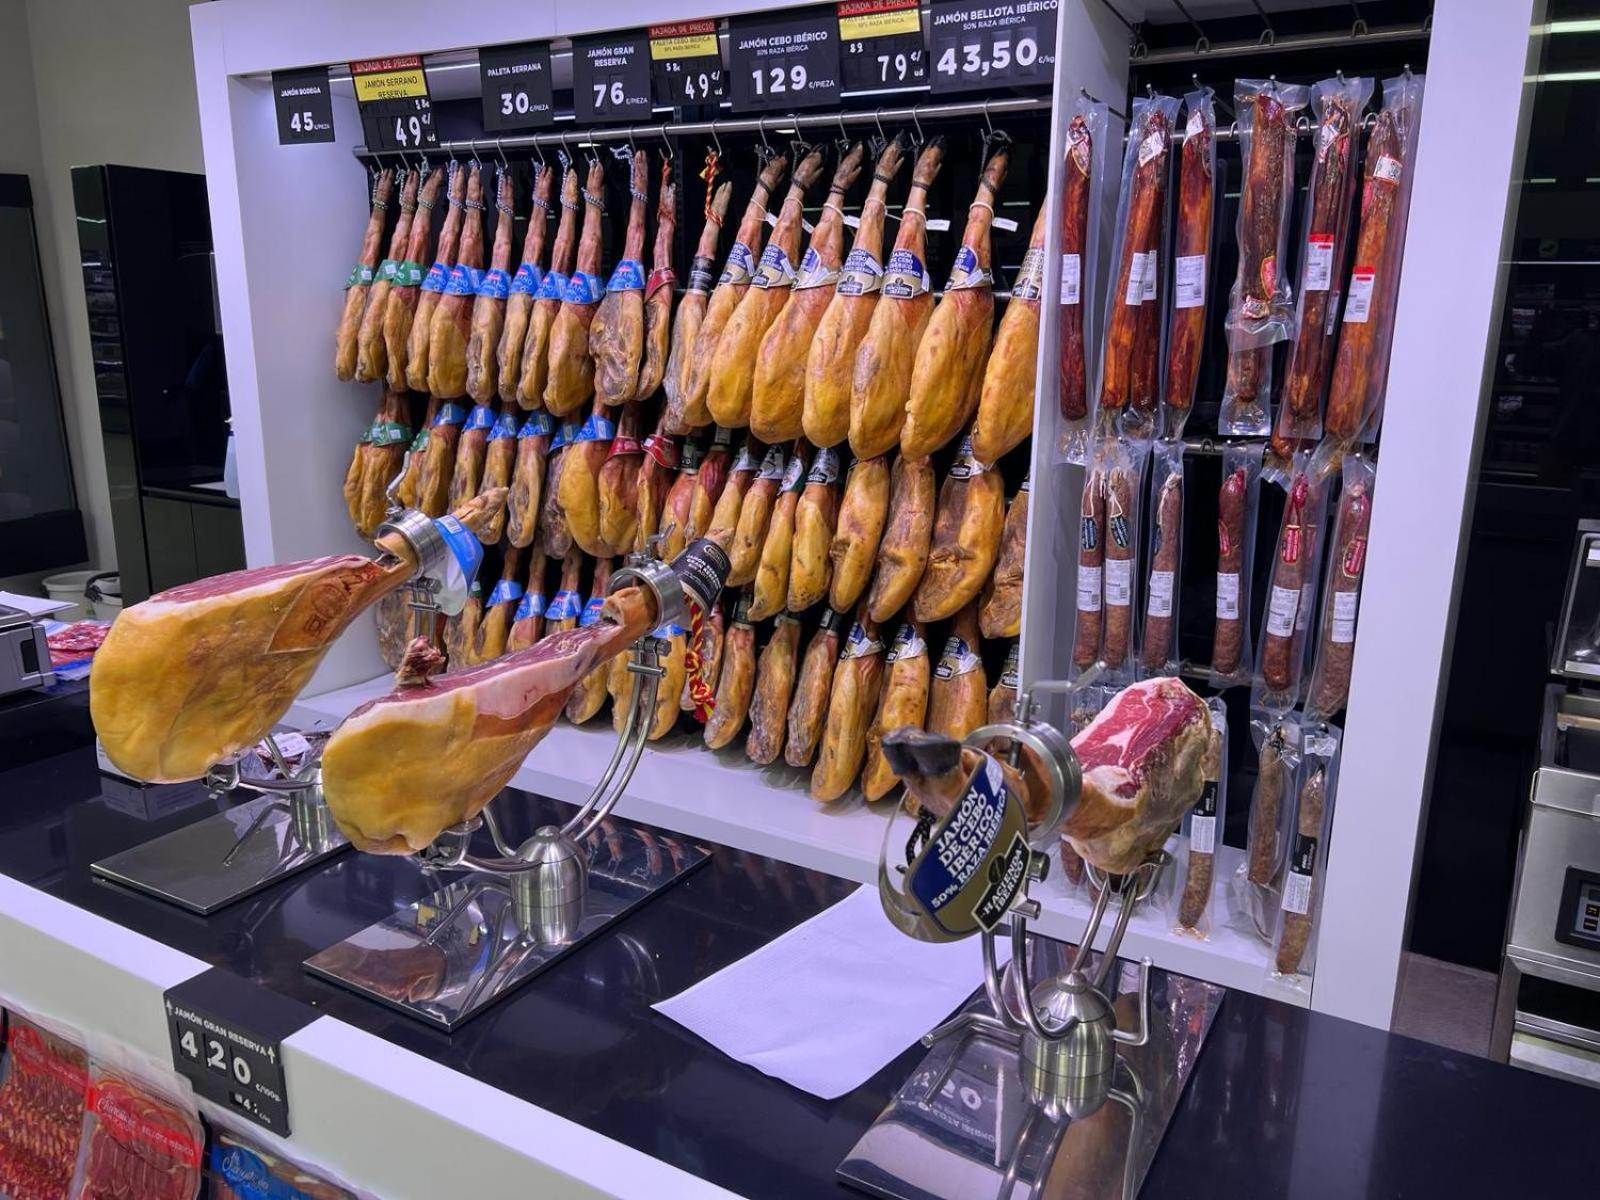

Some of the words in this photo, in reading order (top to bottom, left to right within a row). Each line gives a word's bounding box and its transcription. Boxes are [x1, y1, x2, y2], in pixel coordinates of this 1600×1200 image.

[933, 10, 969, 26] JAMÓN
[970, 5, 1015, 20] BELLOTA
[1016, 0, 1058, 14] IBÉRICO
[978, 19, 998, 28] RAZA
[999, 16, 1026, 26] IBÉRICA
[587, 47, 612, 58] JAMÓN
[613, 46, 635, 55] GRAN
[738, 36, 768, 50] JAMÓN
[769, 35, 793, 46] CEBO
[793, 31, 828, 43] IBÉRICO
[769, 47, 785, 55] RAZA
[785, 45, 809, 53] IBÉRICA
[488, 67, 511, 77] PALETA
[511, 63, 542, 74] SERRANA
[594, 57, 627, 67] RESERVA
[877, 54, 907, 82] 79
[937, 38, 1038, 77] 43,50
[365, 78, 386, 89] JAMÓN
[386, 76, 418, 87] SERRANO
[685, 73, 709, 100] 49
[752, 65, 807, 95] 129
[808, 79, 835, 89] €/PIEZA
[501, 92, 529, 115] 30
[593, 82, 624, 108] 76
[291, 111, 314, 132] 45
[395, 115, 421, 147] 49
[936, 786, 980, 853] JAMÓN
[938, 841, 962, 868] DE
[959, 793, 987, 842] CEBO
[931, 883, 959, 908] 50%
[958, 846, 987, 884] RAZA
[985, 788, 1007, 849] IBÉRICA
[947, 804, 994, 878] IBÉRICO
[982, 848, 1024, 917] HACIENDA
[174, 1006, 203, 1026] JAMÓN
[203, 1020, 228, 1038] GRAN
[227, 1031, 268, 1057] RESERVA
